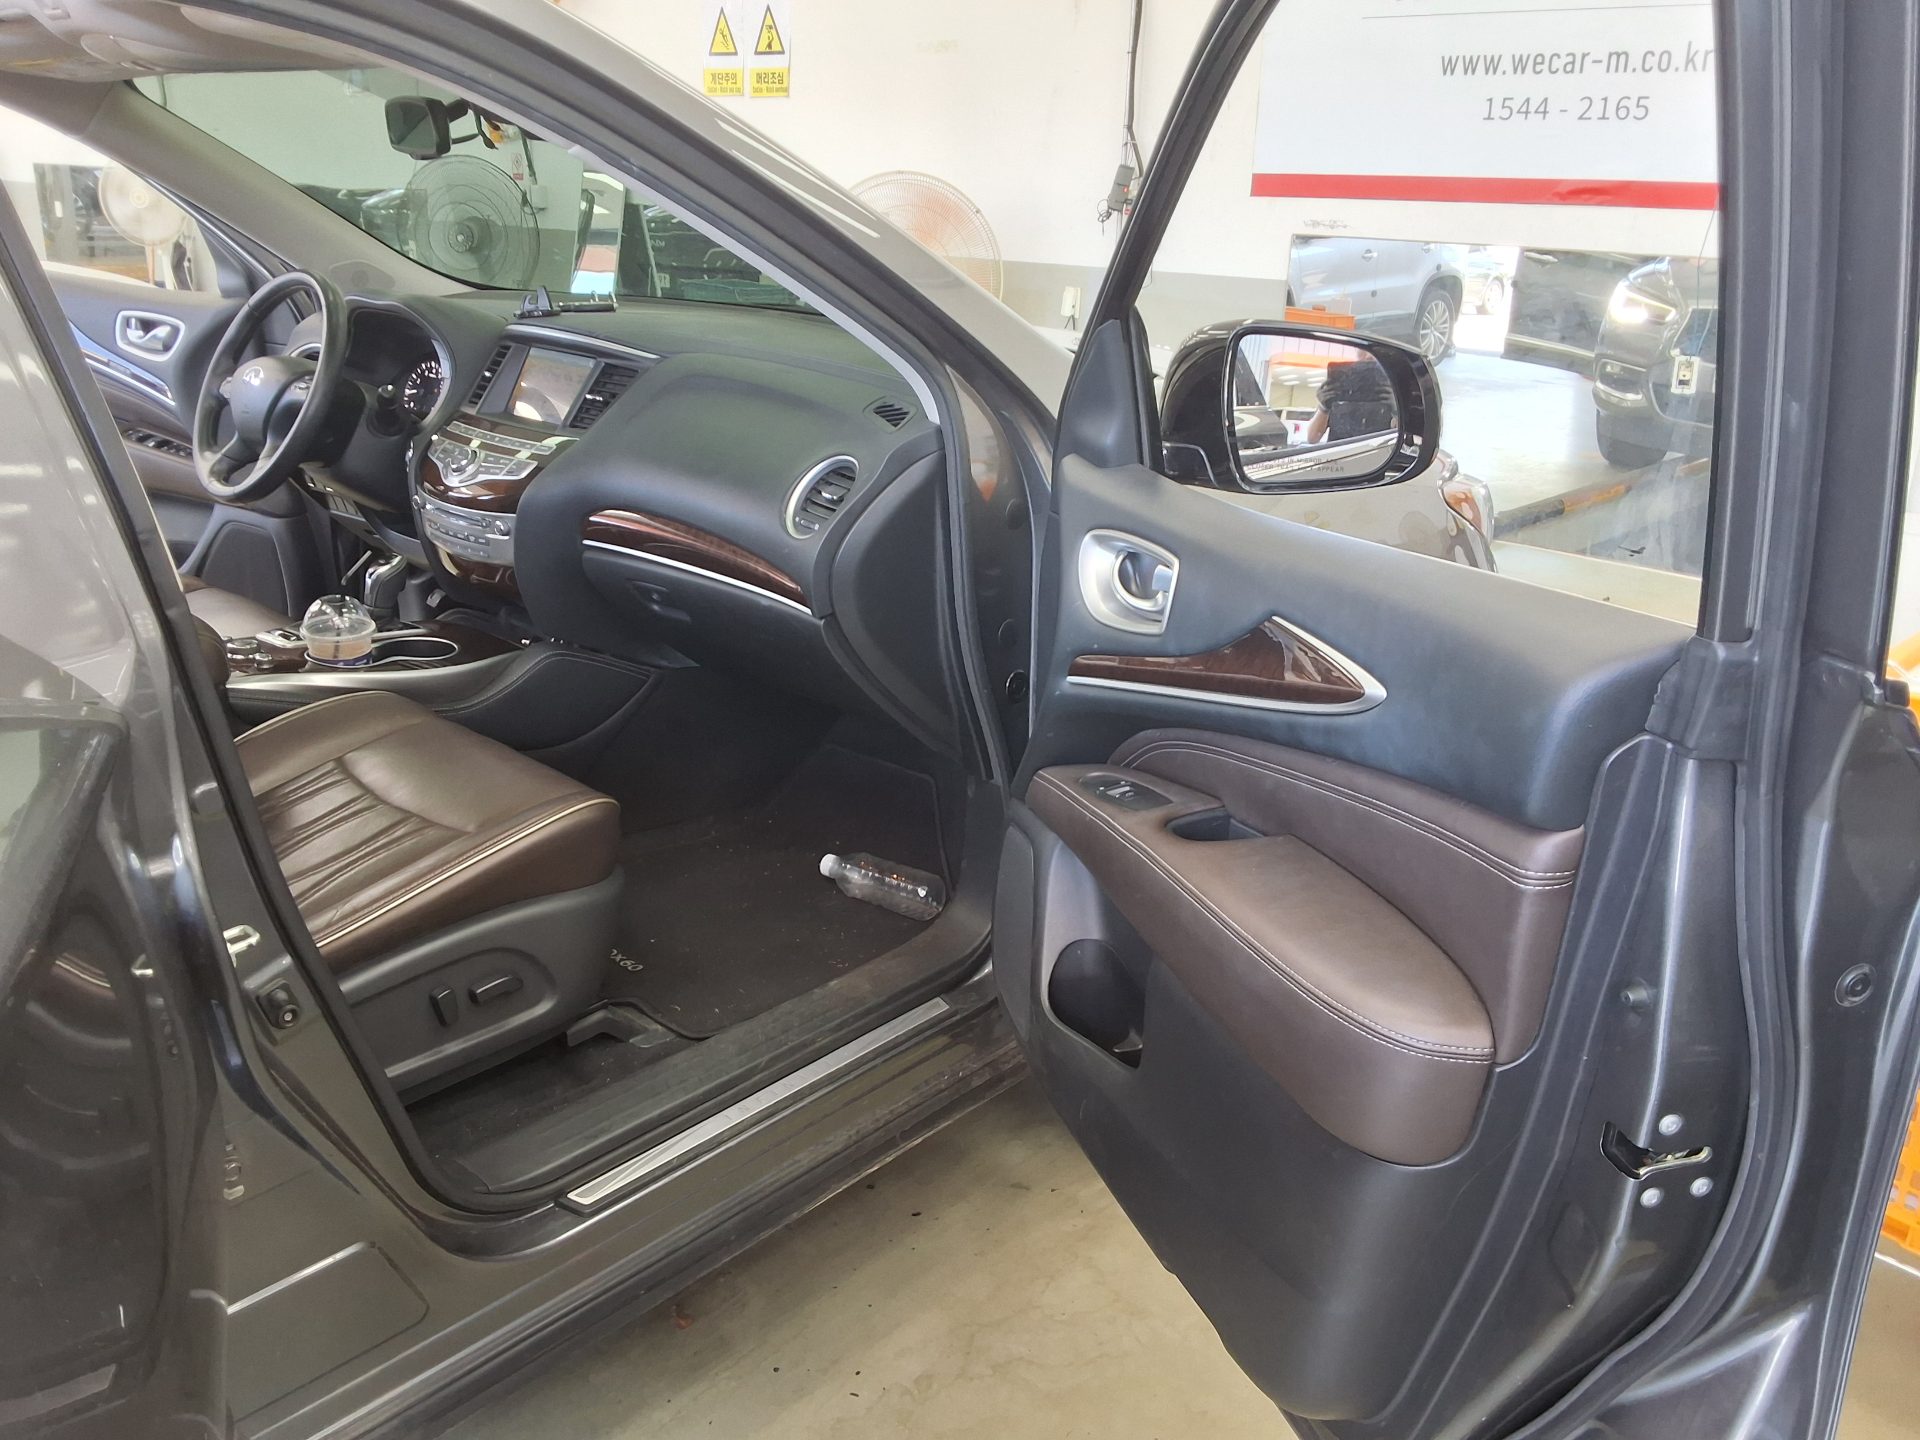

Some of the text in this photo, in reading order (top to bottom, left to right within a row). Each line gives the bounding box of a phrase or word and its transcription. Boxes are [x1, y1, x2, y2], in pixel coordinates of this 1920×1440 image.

[1441, 41, 1714, 76] www.wecar-m.co.kr
[710, 72, 738, 85] 계단주의
[755, 71, 784, 85] 머리조심
[1482, 96, 1550, 121] 1544
[1576, 95, 1651, 121] 2165
